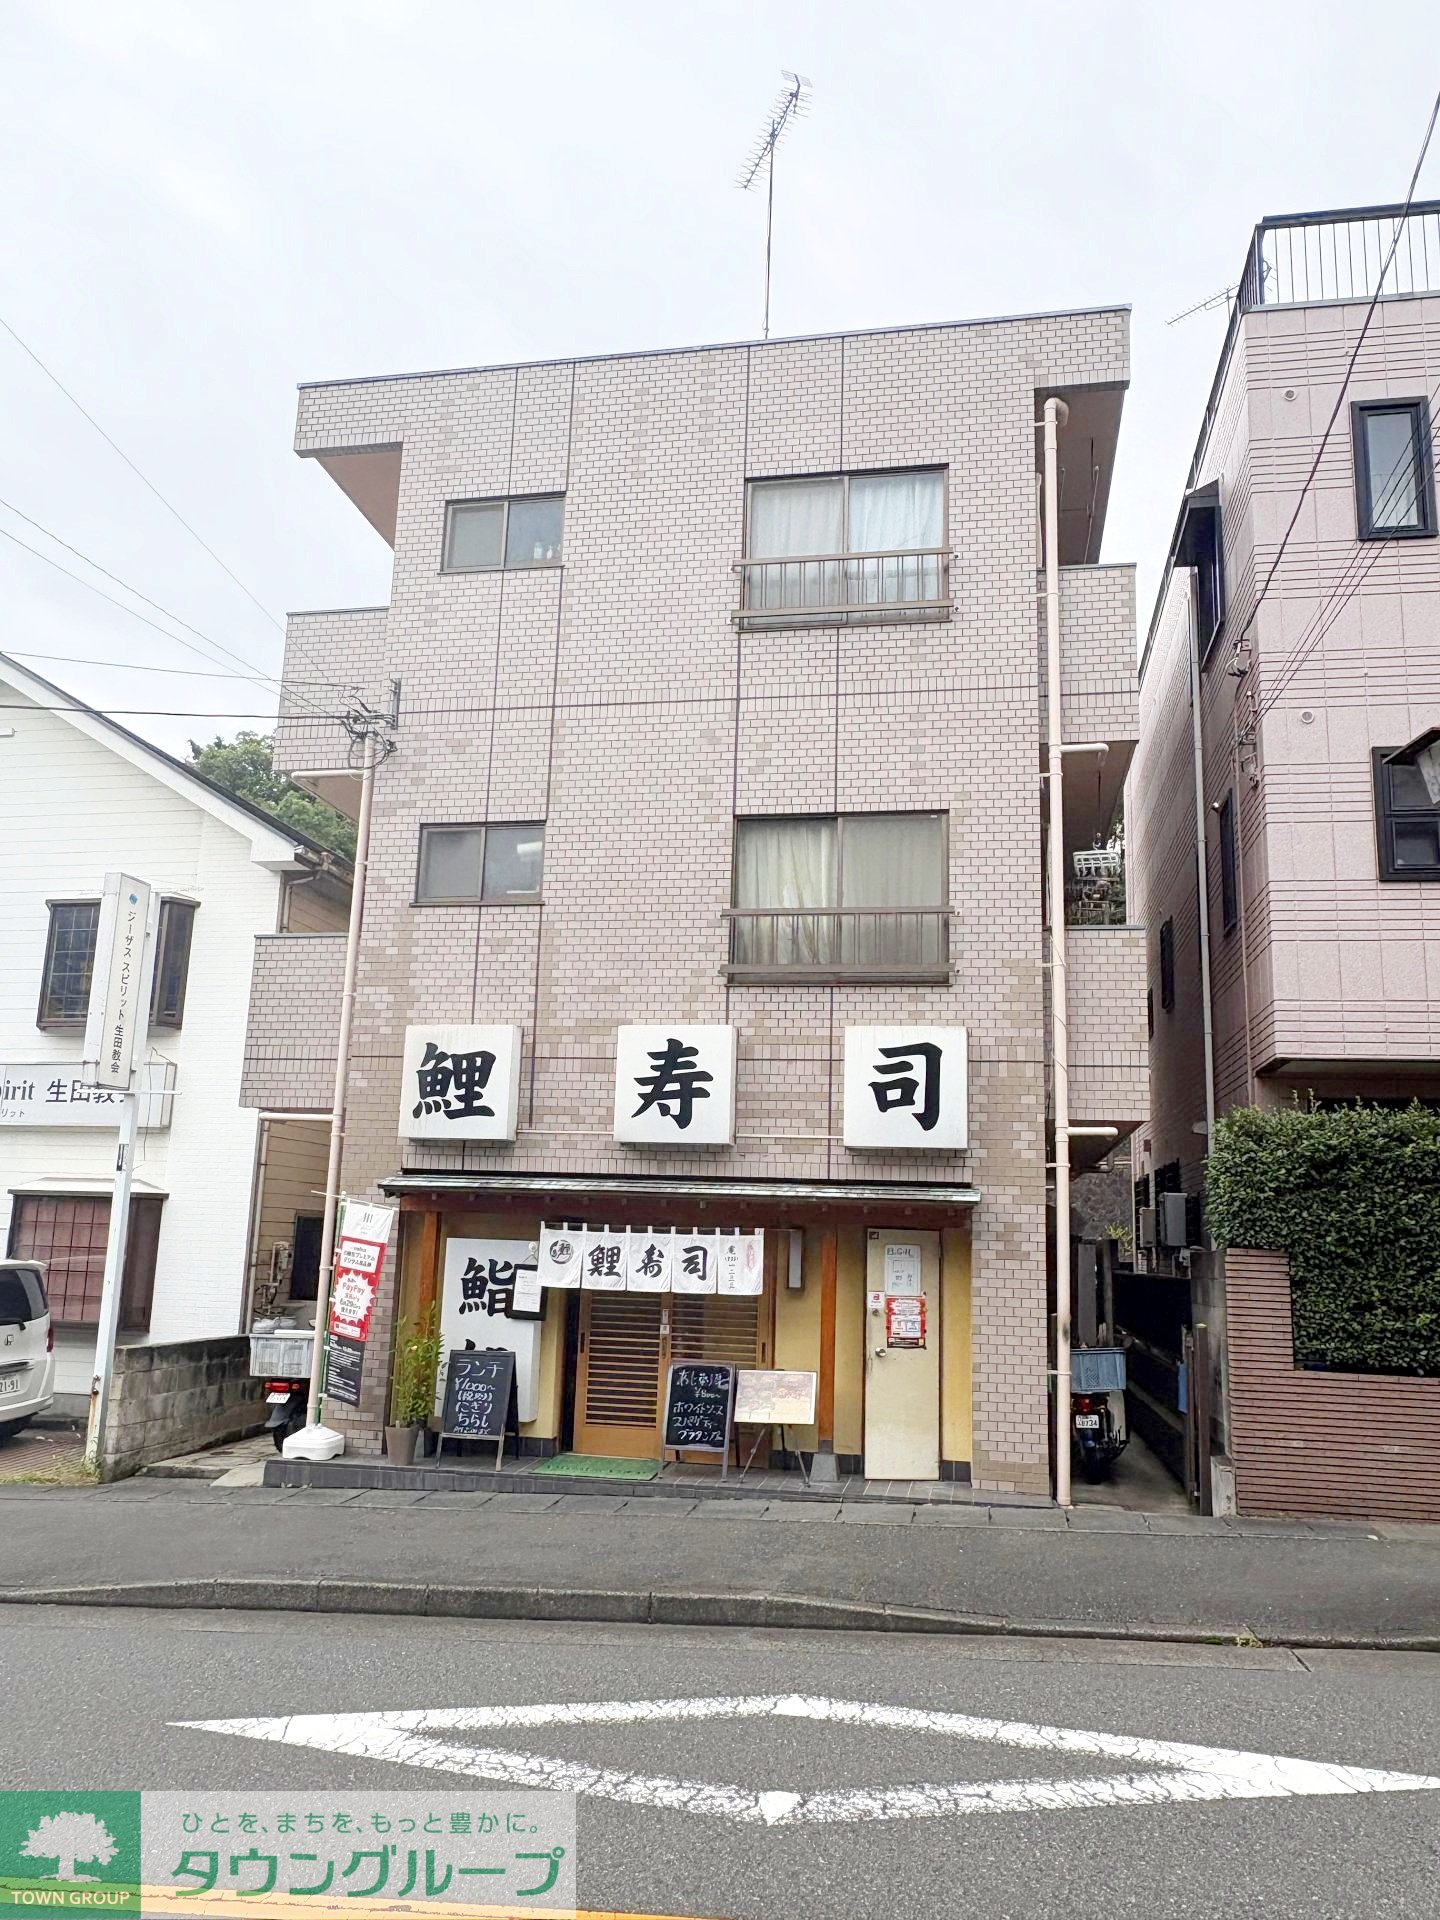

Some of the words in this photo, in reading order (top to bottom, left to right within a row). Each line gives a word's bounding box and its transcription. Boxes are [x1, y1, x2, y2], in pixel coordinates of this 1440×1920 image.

[118, 961, 130, 1020] スピリット
[110, 1024, 124, 1073] 生田教会
[0, 1080, 35, 1101] irit
[45, 1078, 125, 1103] 生田教
[630, 1036, 713, 1130] 寿
[867, 1041, 943, 1132] 司
[342, 1282, 366, 1295] PayPay
[456, 1358, 504, 1378] ランチ
[455, 1402, 493, 1415] にぎり
[457, 1413, 489, 1428] ちらし
